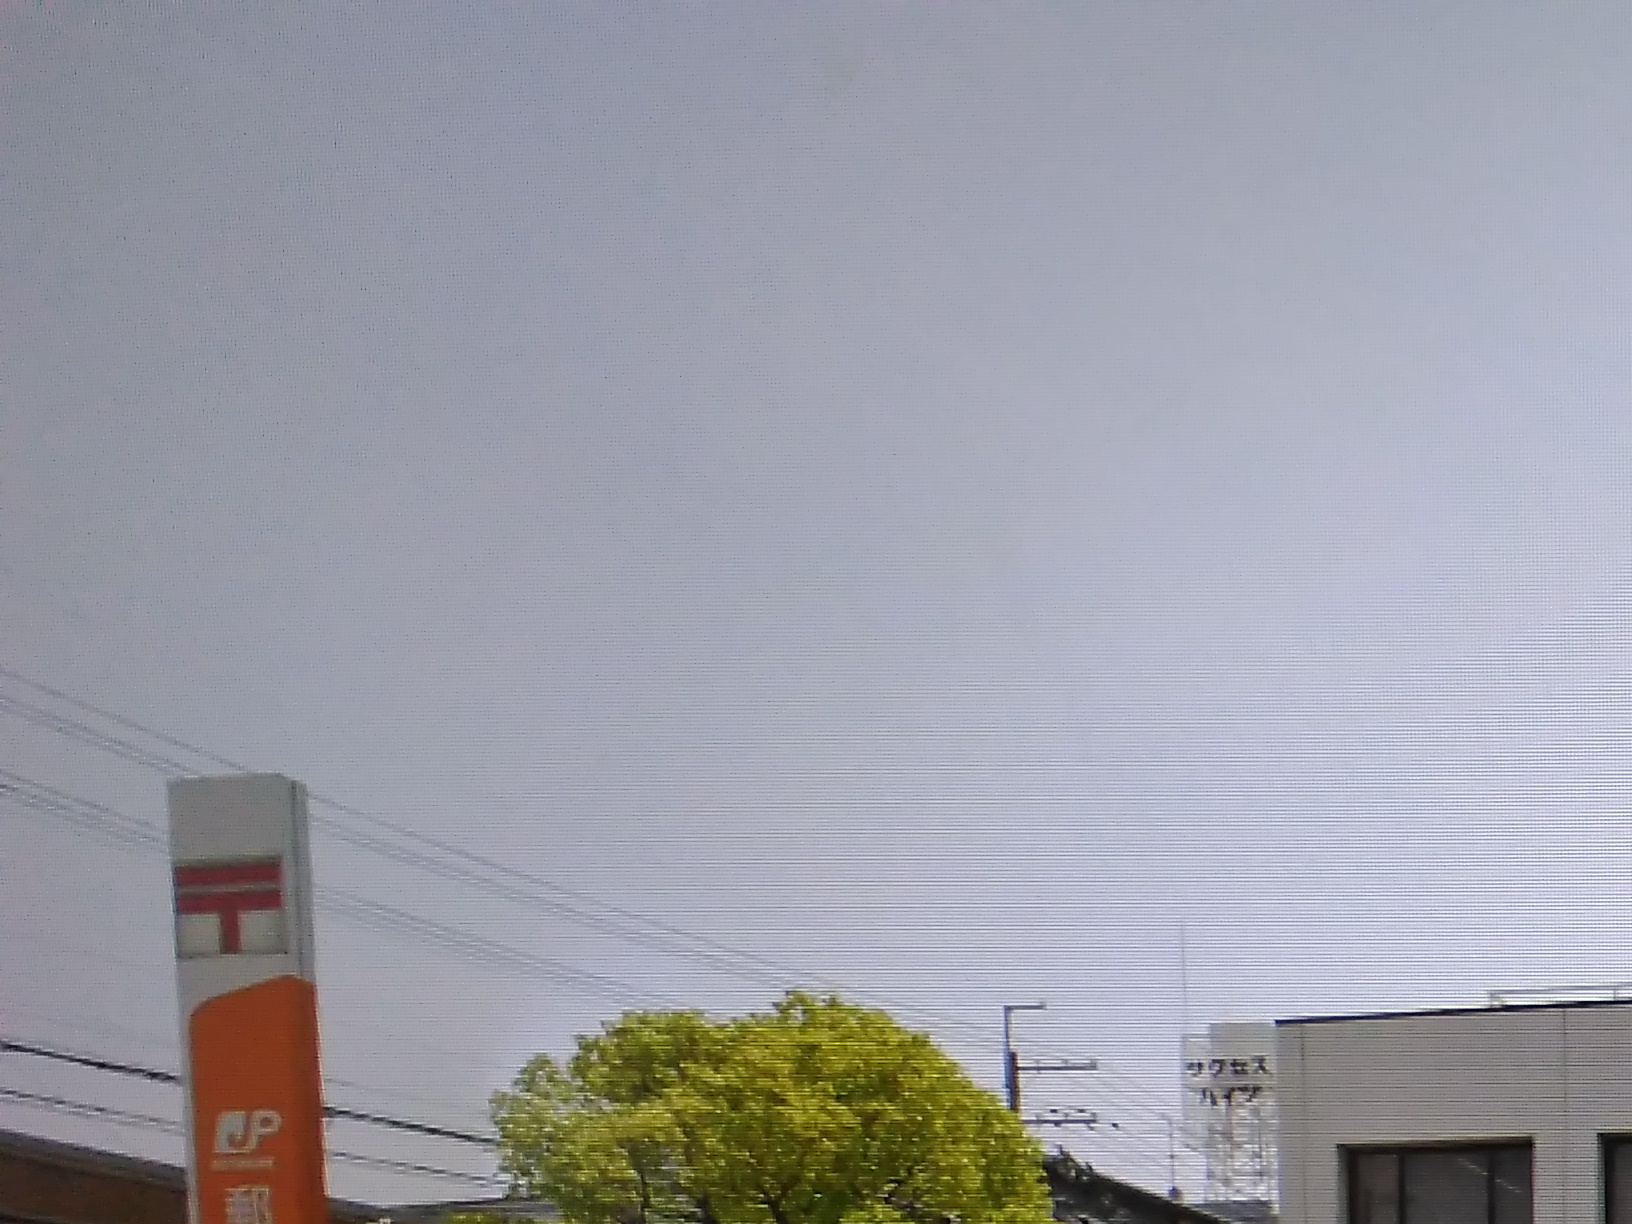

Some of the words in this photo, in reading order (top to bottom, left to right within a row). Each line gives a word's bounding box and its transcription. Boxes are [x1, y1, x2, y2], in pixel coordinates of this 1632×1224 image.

[1184, 1056, 1273, 1078] サクセス
[213, 1110, 283, 1155] JP
